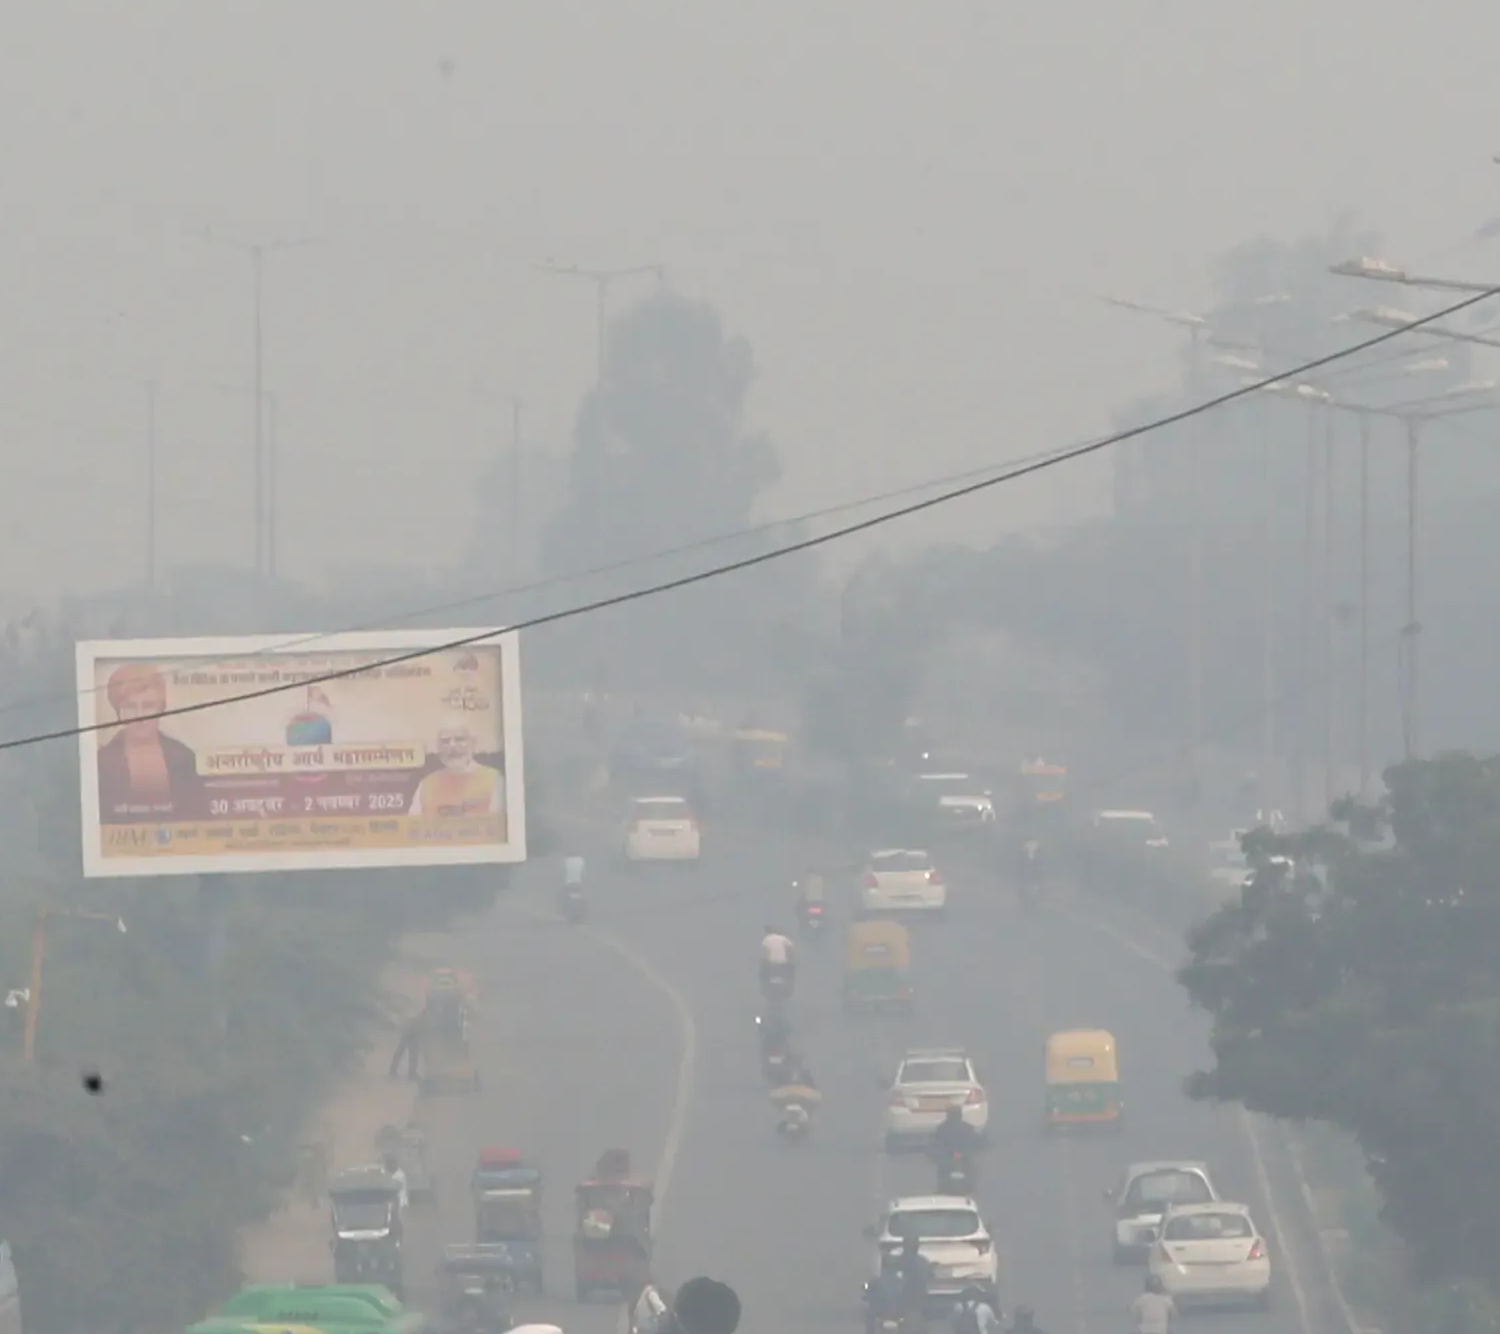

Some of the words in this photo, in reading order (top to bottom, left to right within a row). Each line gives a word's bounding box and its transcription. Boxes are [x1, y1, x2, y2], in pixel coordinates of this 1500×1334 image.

[209, 799, 229, 815] 30
[304, 797, 314, 811] 2
[368, 793, 404, 809] 2025
